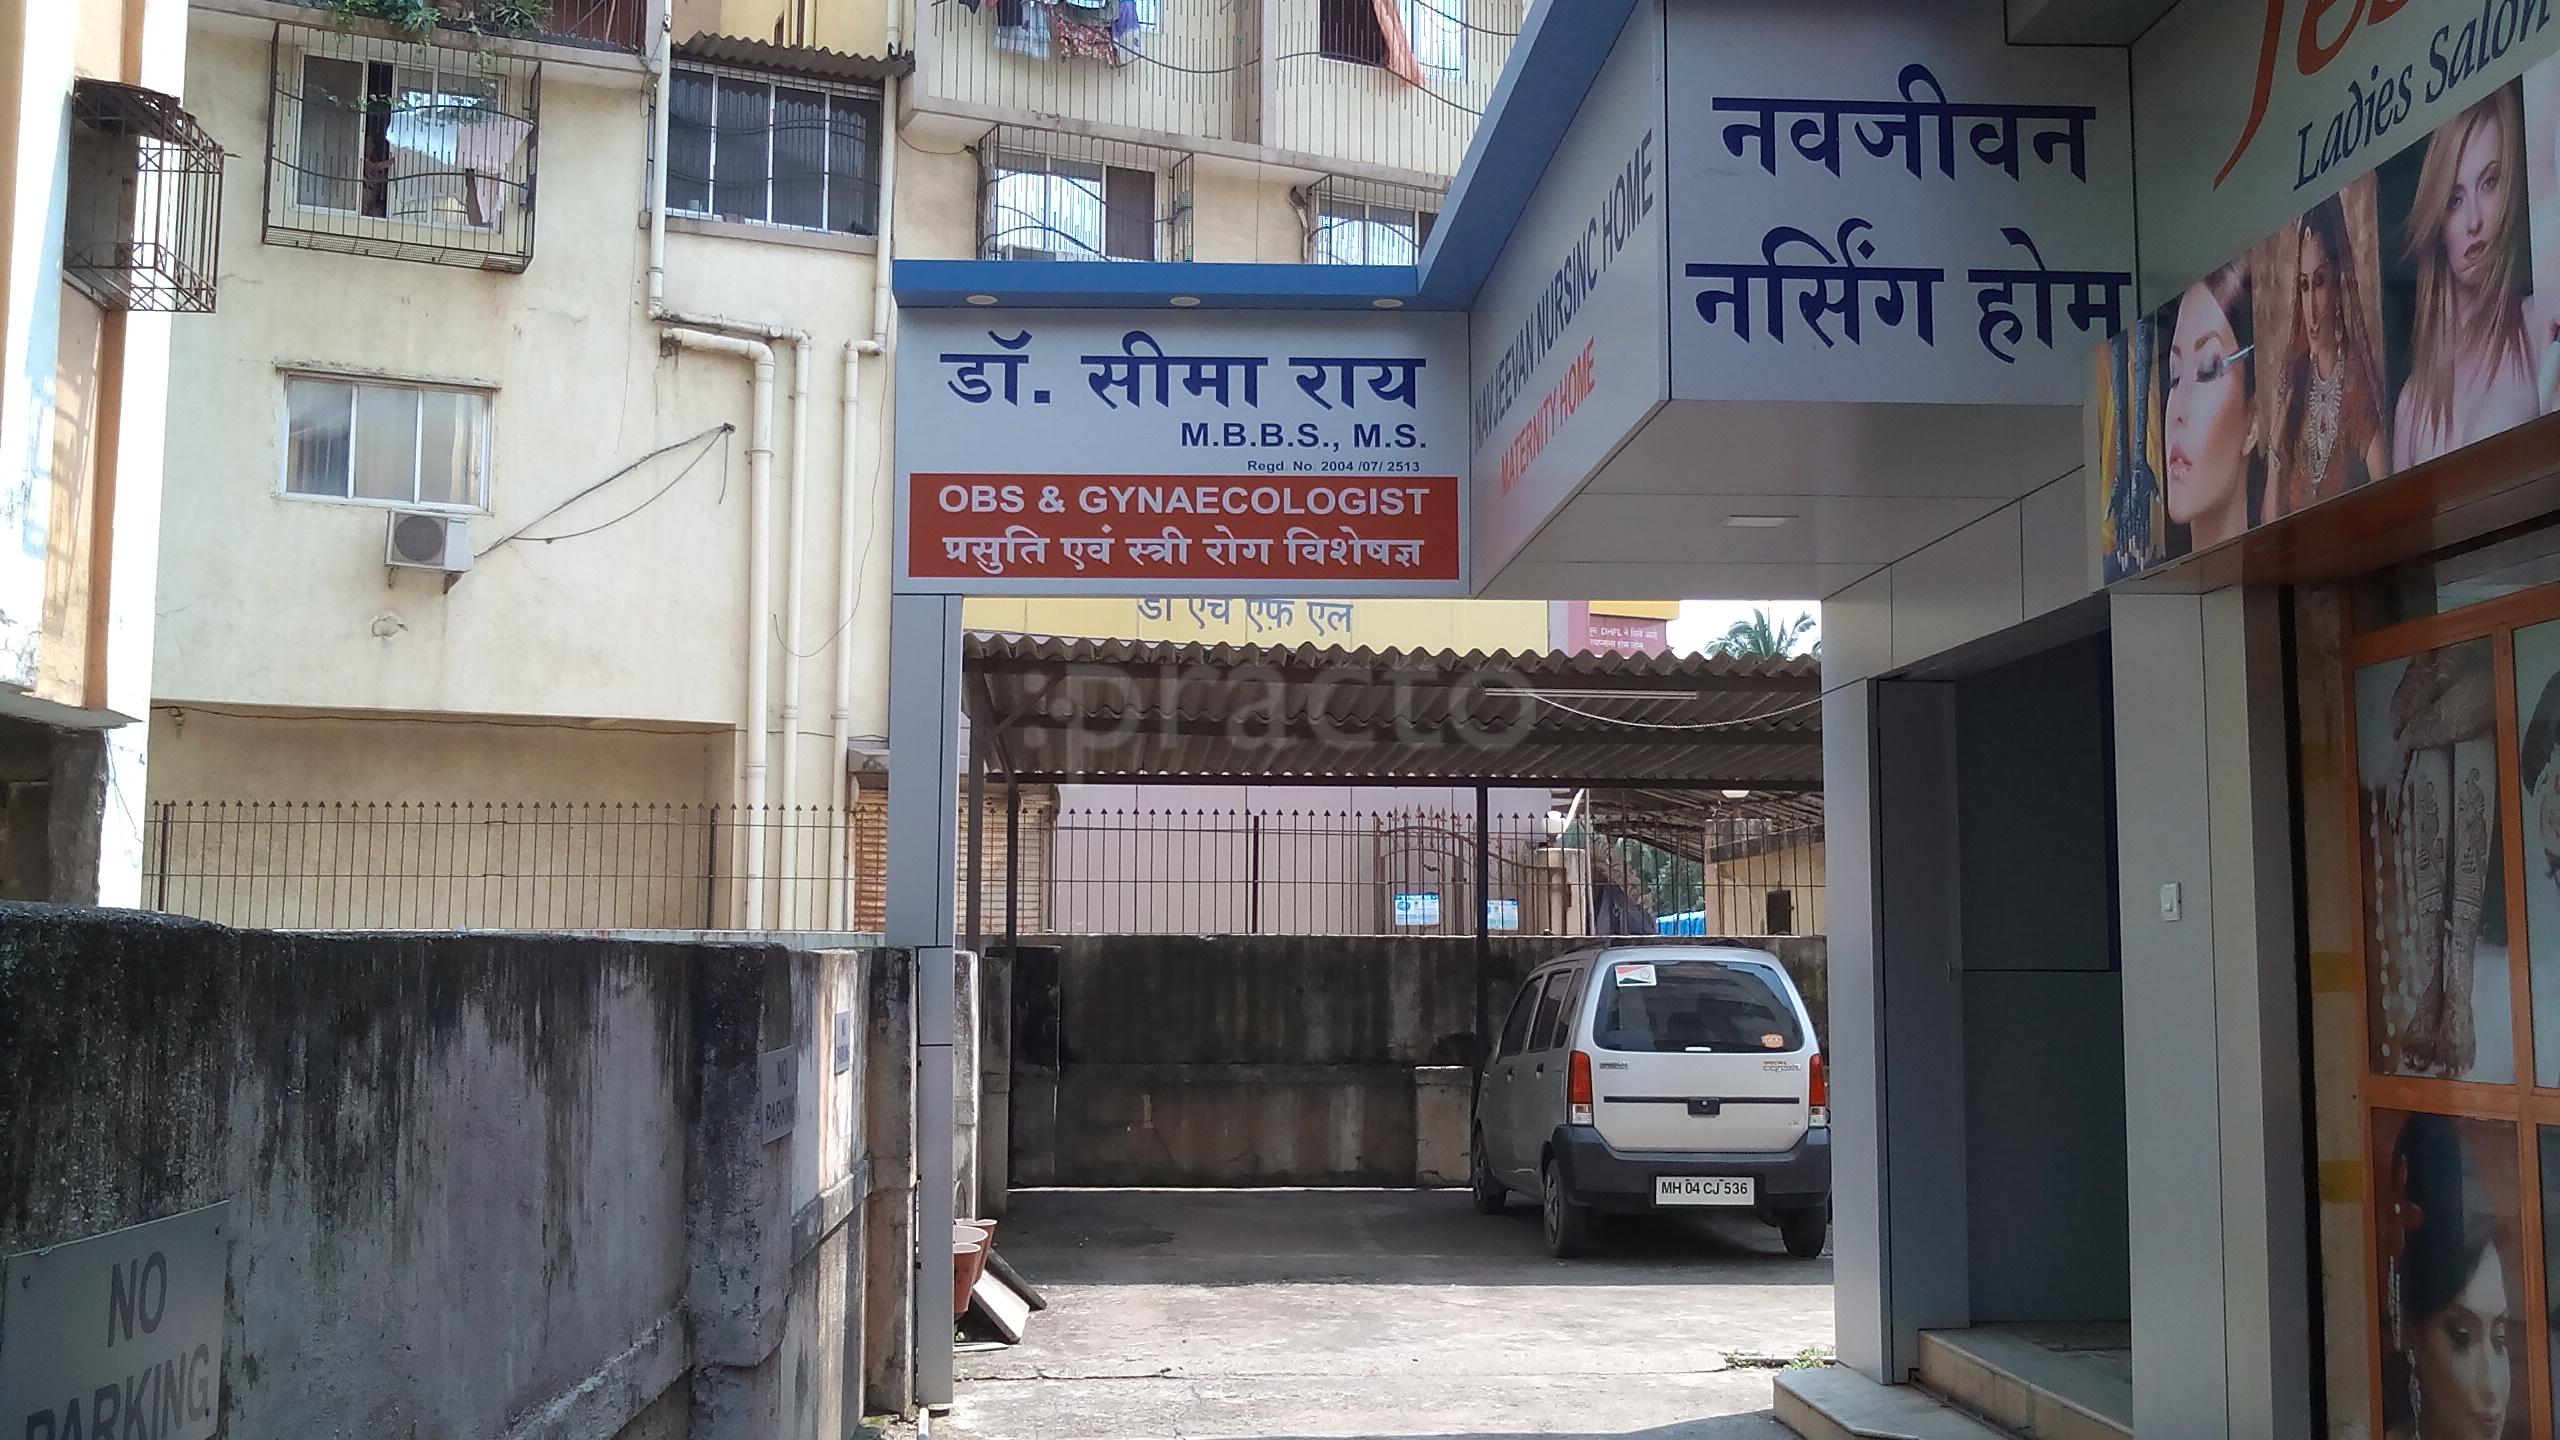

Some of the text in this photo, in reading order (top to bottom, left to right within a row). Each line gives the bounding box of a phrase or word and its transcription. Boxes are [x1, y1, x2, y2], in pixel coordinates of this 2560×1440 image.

[1712, 63, 2096, 183] नवजीवन
[2212, 0, 2410, 191] Je
[2293, 0, 2549, 192] Ladies Salon
[1475, 312, 1534, 454] NAVJEEVAN
[1602, 128, 1653, 272] HOME
[1685, 218, 2132, 364] नर्सिंग होम
[939, 329, 1427, 410] डॉ. सीमा राय
[1181, 422, 1427, 452] M.B.B.S., M.S.
[1501, 336, 1596, 498] MATERNITY HOME
[938, 485, 1431, 515] OBS & GYNAECOLOGIST
[1321, 460, 1354, 472] 2004
[1358, 461, 1383, 472] /07/
[1387, 461, 1420, 472] 2513
[941, 523, 1425, 575] प्रसुति एवं स्त्री रोग विशेषज्ञ
[1306, 602, 1354, 637] एल
[1661, 1181, 1749, 1196] MH 04 CJ 536
[107, 1251, 168, 1349] NO
